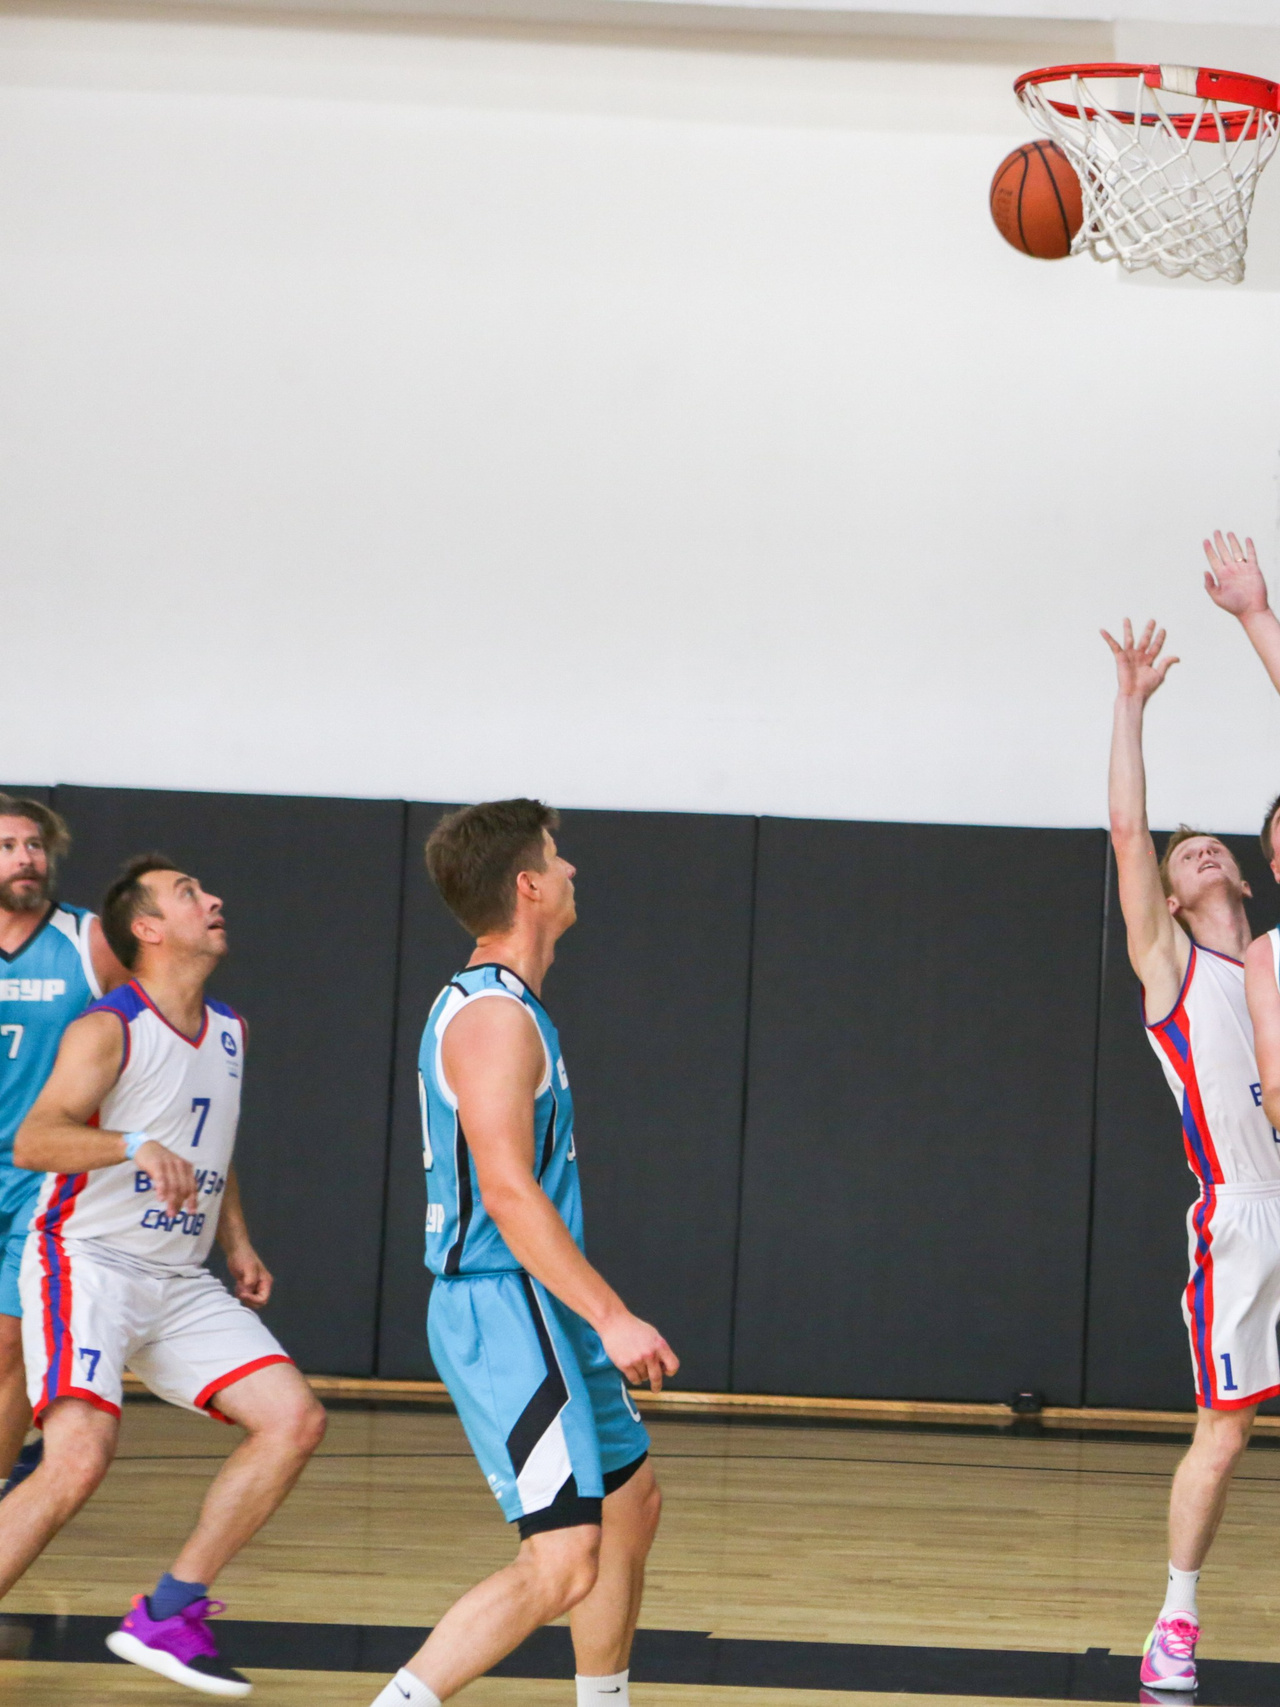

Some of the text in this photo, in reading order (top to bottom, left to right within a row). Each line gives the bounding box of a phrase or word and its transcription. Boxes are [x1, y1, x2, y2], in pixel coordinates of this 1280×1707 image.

[0, 1024, 24, 1060] 7
[191, 1097, 211, 1147] 7
[140, 1208, 207, 1237] САРОВ
[79, 1346, 102, 1383] 7
[1220, 1352, 1239, 1391] 1
